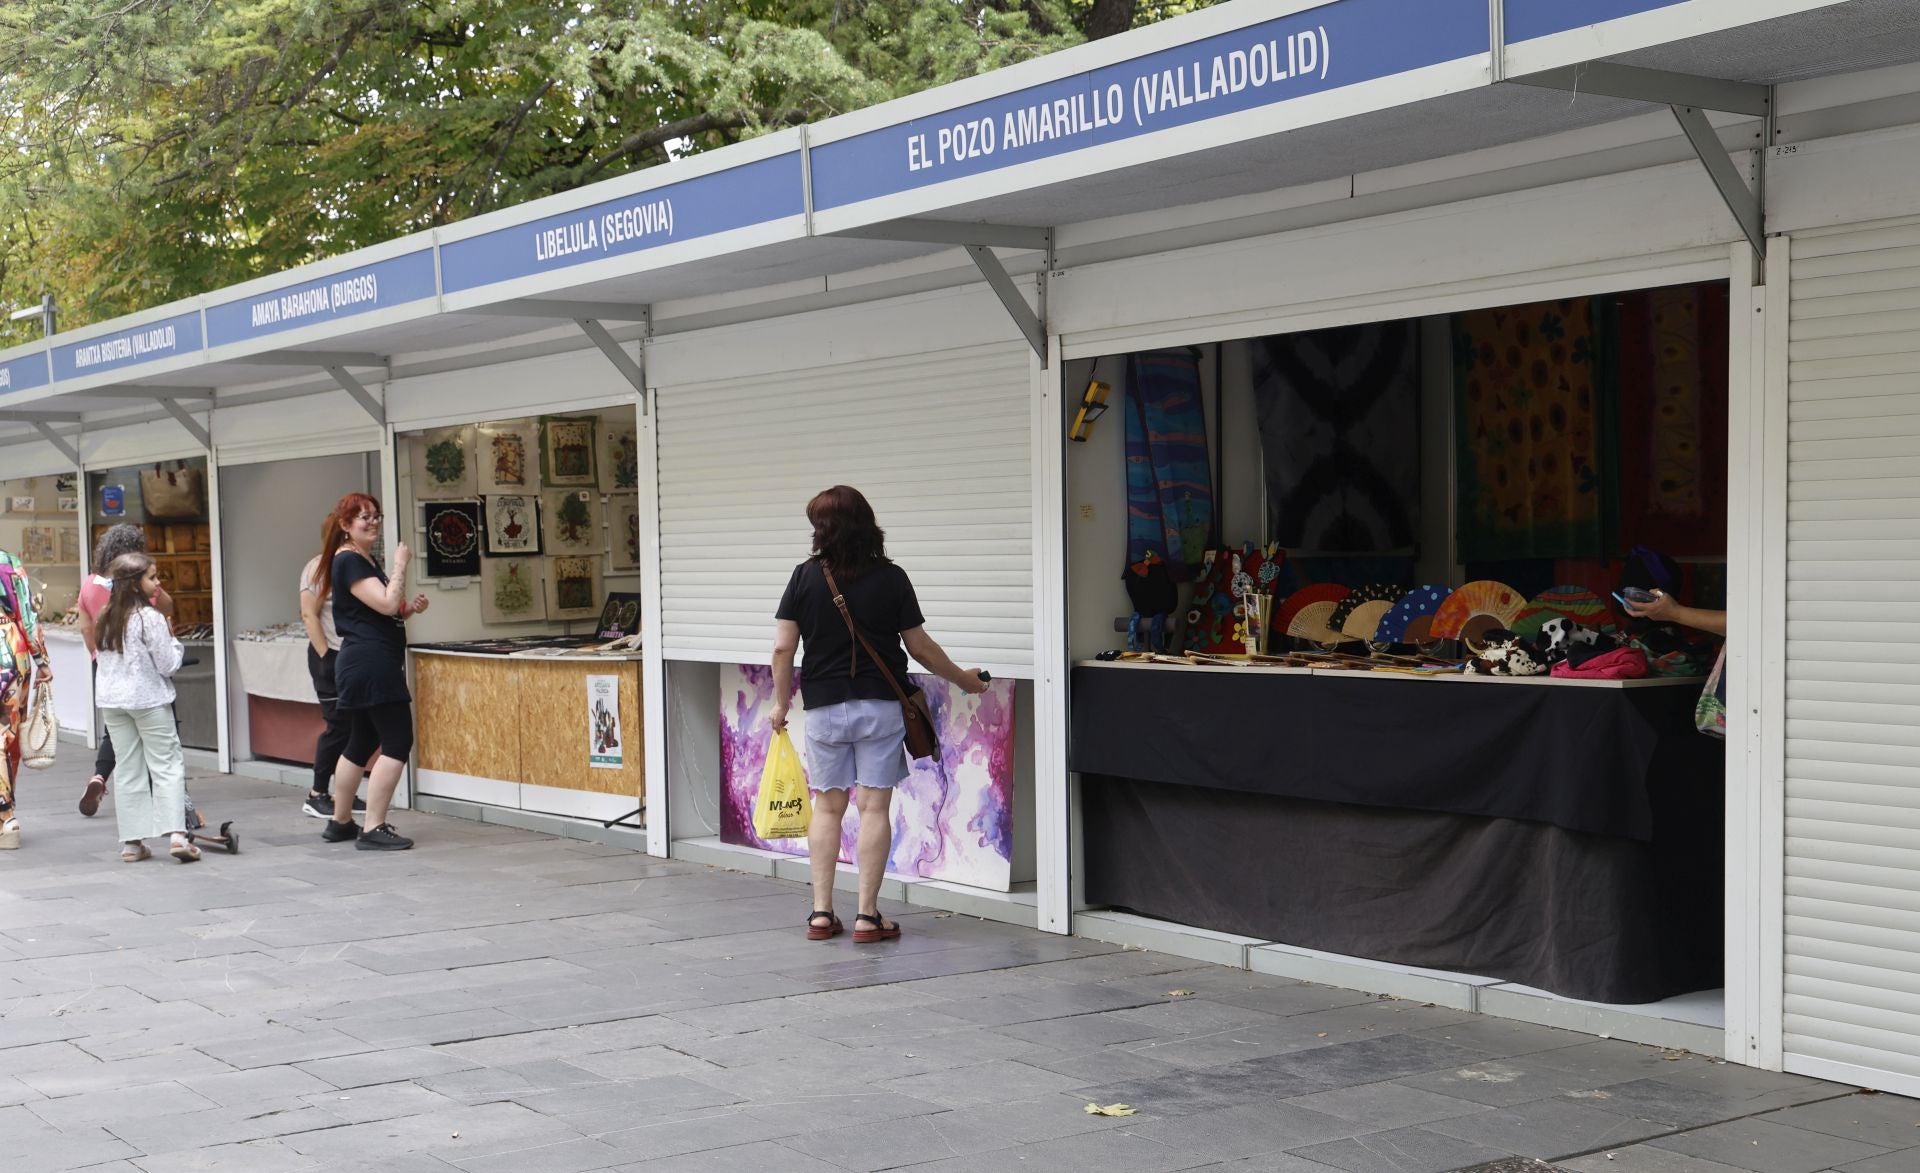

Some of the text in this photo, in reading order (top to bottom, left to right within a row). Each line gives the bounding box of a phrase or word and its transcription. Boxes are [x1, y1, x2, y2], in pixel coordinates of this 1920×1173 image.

[907, 25, 1330, 172] EL POZO AMARILLO (VALLADOLID)
[535, 198, 674, 261] LIBELULA (SEGOVIA)
[251, 273, 377, 327] AMAYA BARAHONA (BURGOS)
[75, 325, 176, 368] ARANTXA BISUTERIA (VALLADOLID)
